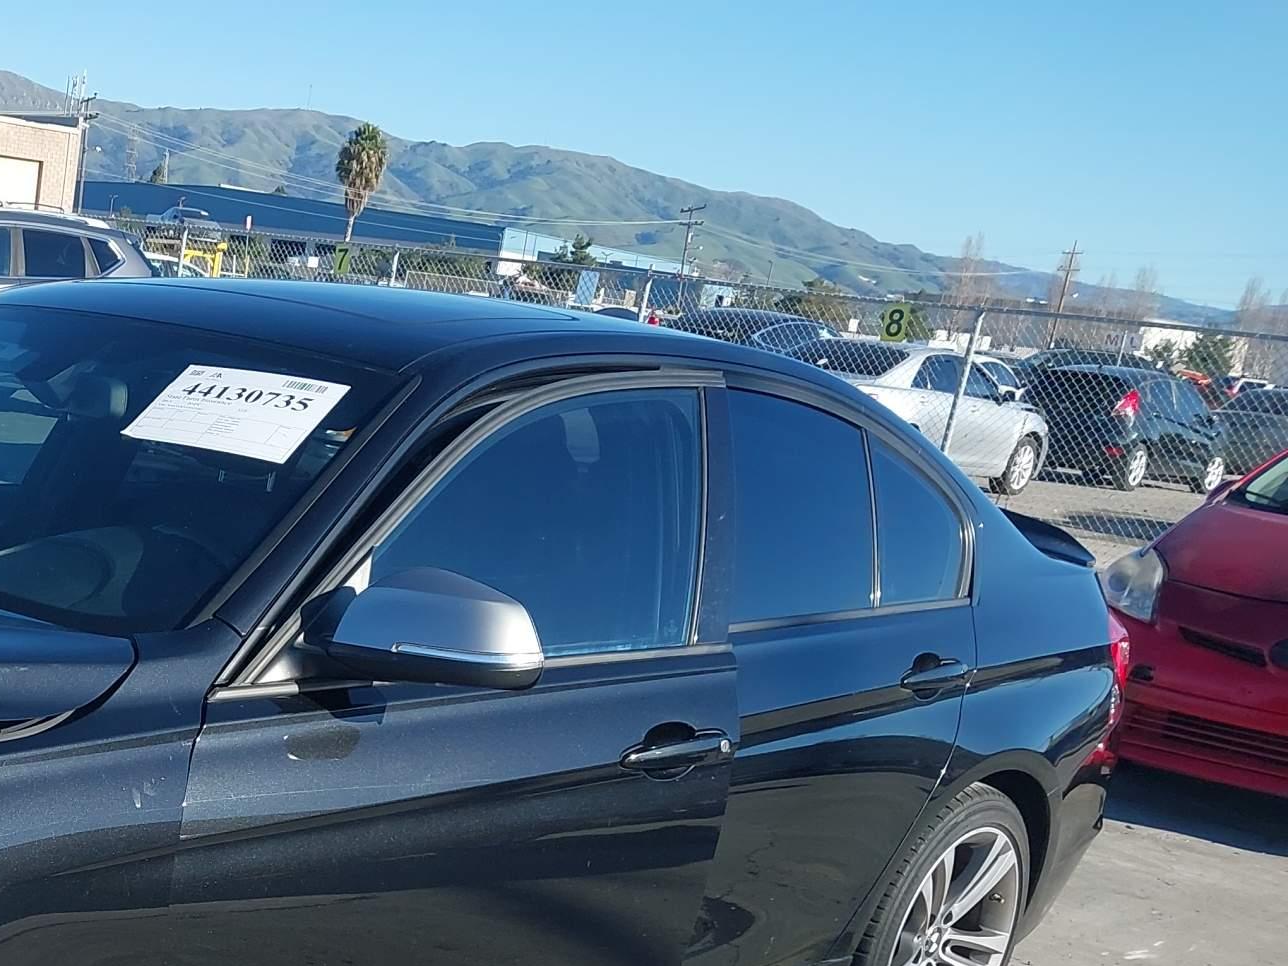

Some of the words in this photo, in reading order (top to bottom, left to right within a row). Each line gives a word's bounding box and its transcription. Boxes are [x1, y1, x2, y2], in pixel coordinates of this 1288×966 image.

[338, 248, 349, 270] 7
[885, 308, 904, 337] 8
[182, 382, 314, 411] 44130735
